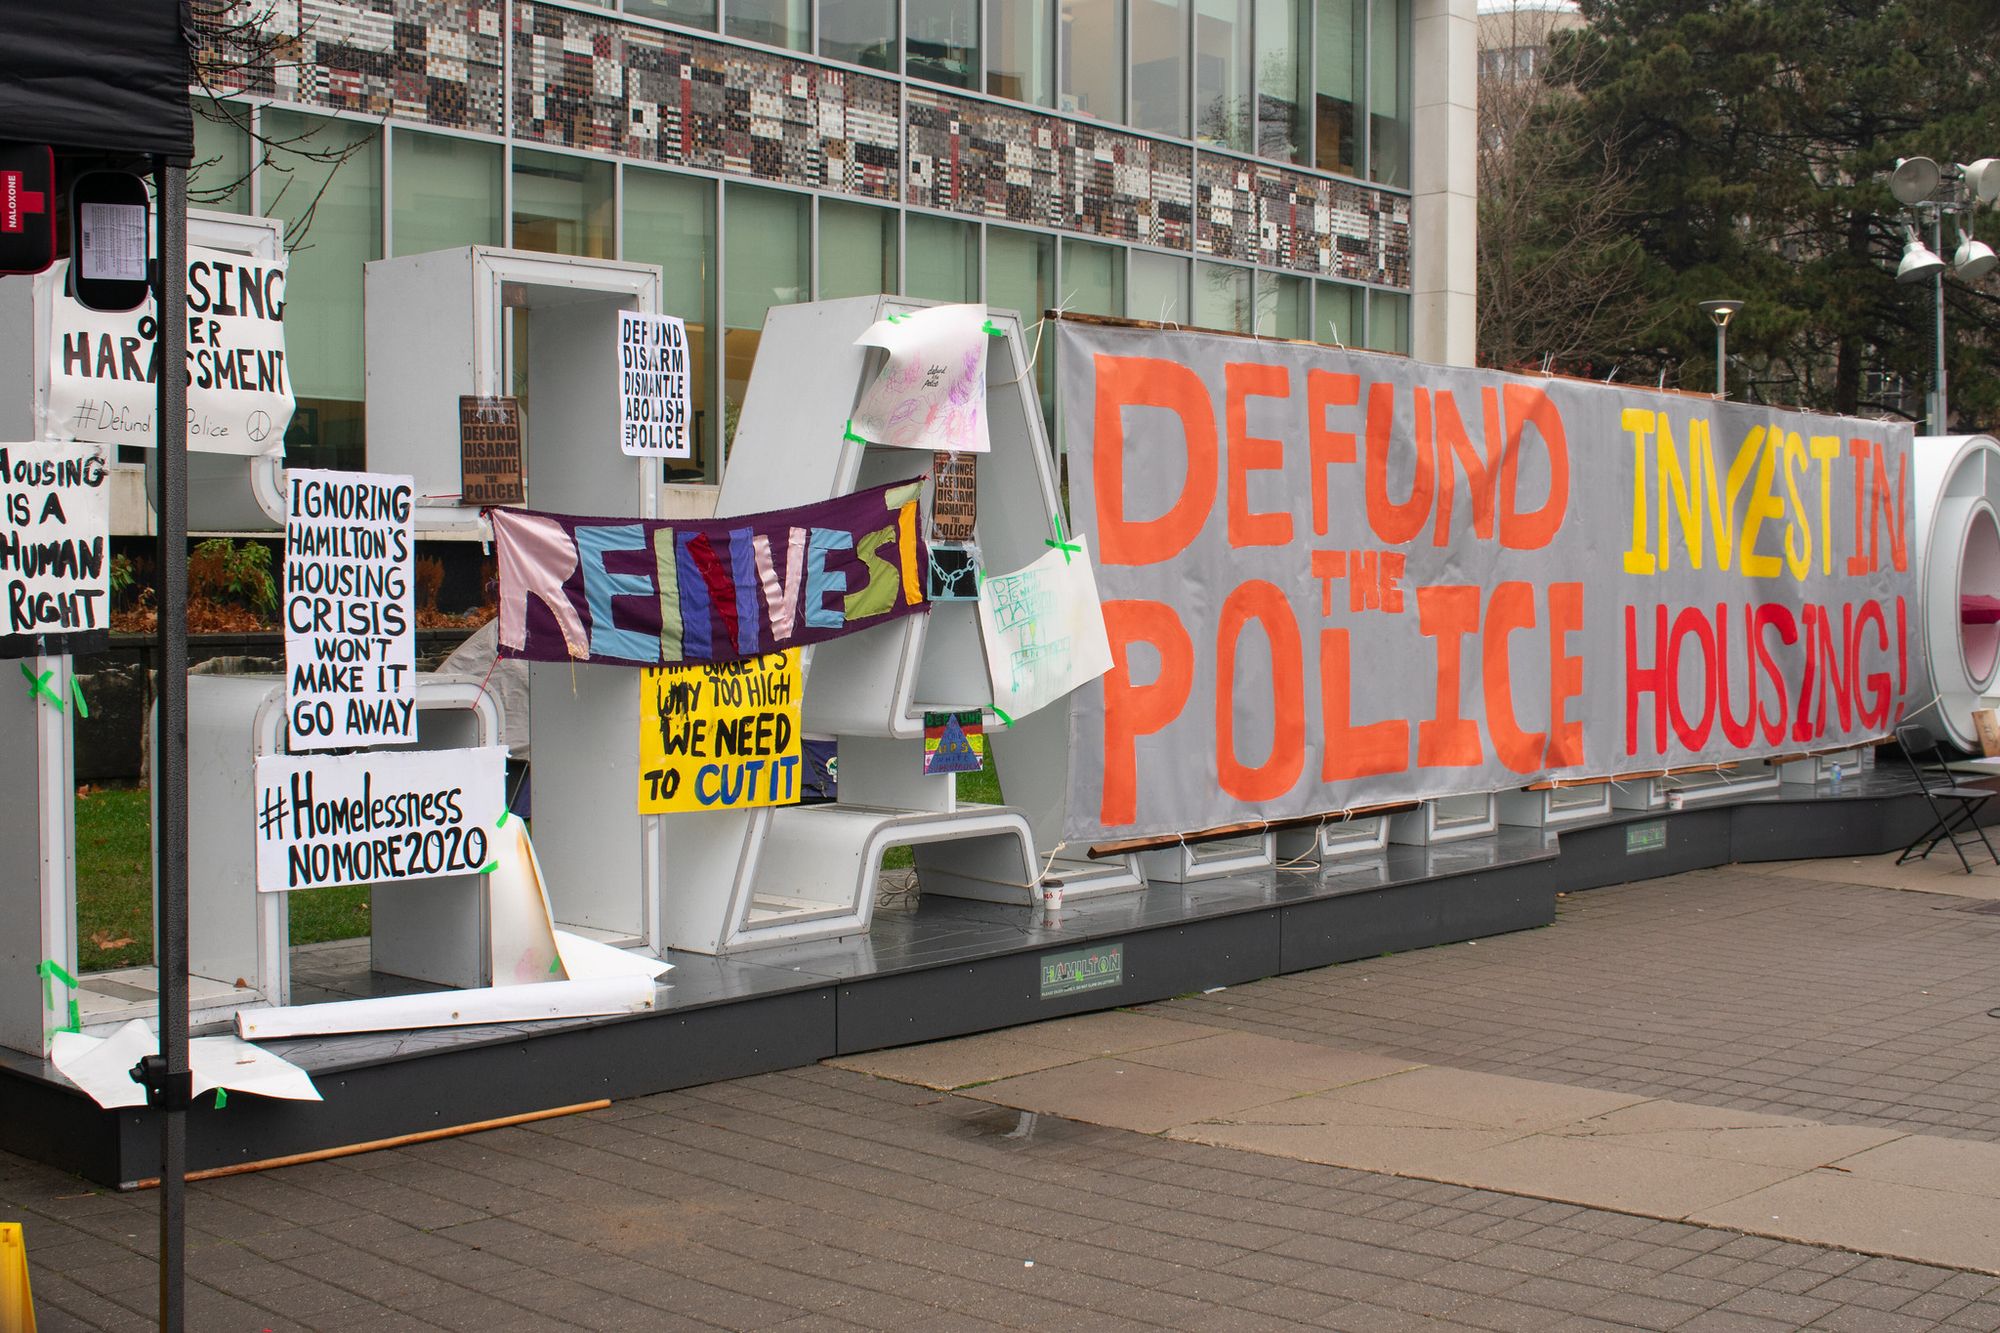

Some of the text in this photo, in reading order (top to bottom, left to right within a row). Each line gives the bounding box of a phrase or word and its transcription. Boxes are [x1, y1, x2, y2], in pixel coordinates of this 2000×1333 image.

[8, 175, 17, 228] NALOXONE
[138, 315, 221, 348] OER
[623, 318, 682, 348] DEFUND
[623, 345, 684, 373] DISARM
[624, 372, 684, 398] DISMANTLE
[73, 398, 151, 433] #Defund
[625, 397, 684, 424] ABOLISH
[464, 426, 516, 441] DEFUND
[464, 442, 516, 458] DISARM
[631, 424, 684, 450] POLICE
[465, 458, 518, 474] DISMANTLE
[1093, 352, 1570, 566] DEFUND
[466, 484, 519, 500] POLICE!
[484, 475, 498, 483] THE
[937, 476, 974, 489] DEFUND
[937, 489, 974, 503] DISARM
[1621, 408, 1907, 581] INVEST IN
[6, 492, 67, 527] IS A
[290, 478, 412, 524] IGNORING
[937, 502, 974, 517] DISMANTLE
[288, 522, 408, 563] HAMILTON'S
[936, 522, 974, 537] POLICE!
[0, 530, 104, 580] HUMAN
[492, 480, 925, 664] REINVEST
[288, 561, 406, 600] HOUSING
[1310, 548, 1406, 617] THE
[8, 579, 104, 632] RIGHT
[288, 595, 407, 636] CRISIS
[315, 637, 392, 663] WON'T
[293, 663, 408, 696] MAKE IT
[709, 676, 743, 708] TOO
[746, 672, 791, 708] HIGH
[1625, 595, 1908, 756] HOUSING!
[293, 698, 414, 737] GO AWAY
[1100, 578, 1585, 826] POLICE
[660, 712, 792, 758] WE NEED
[644, 755, 799, 806] TO CUT IT
[259, 770, 463, 840] #Homelessness
[1042, 953, 1120, 985] HAMILTON
